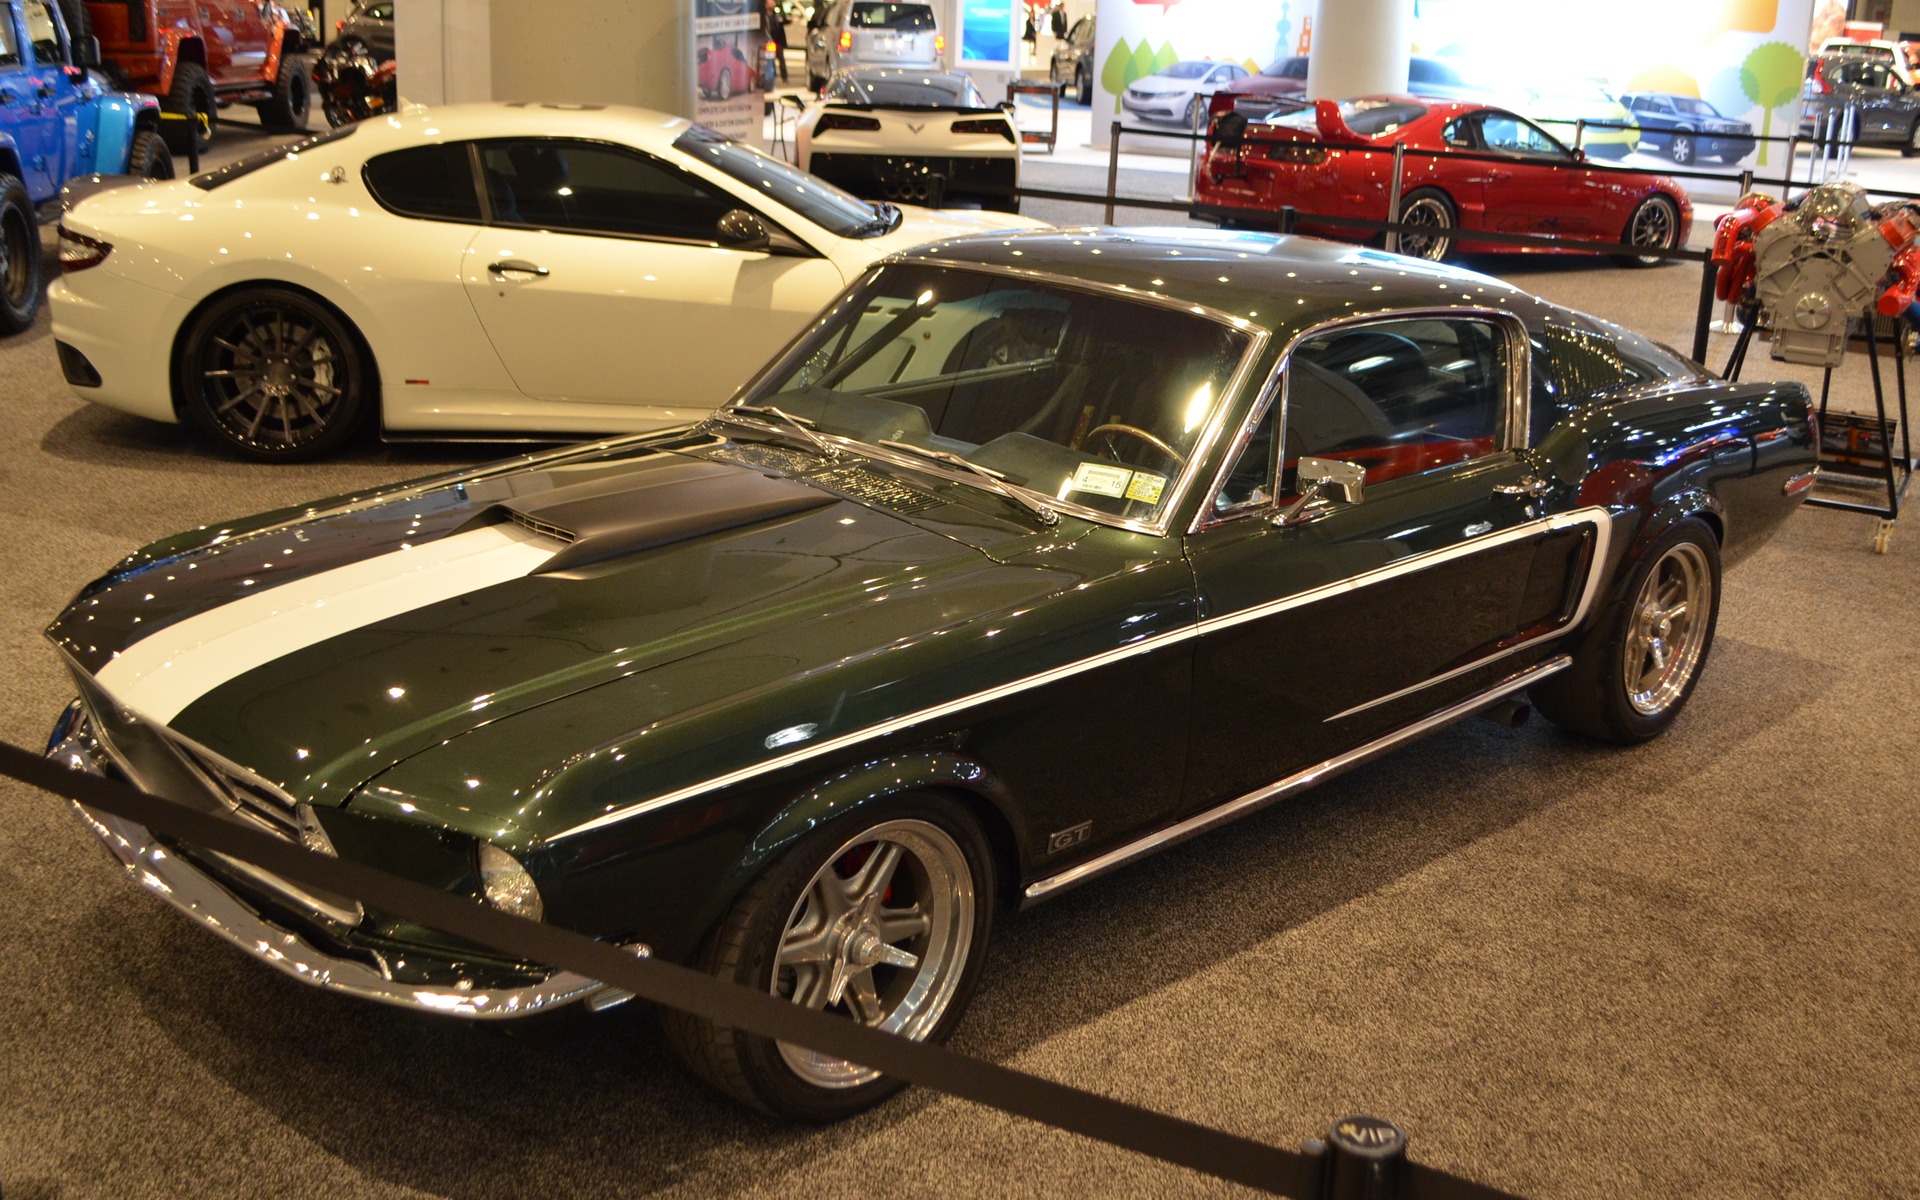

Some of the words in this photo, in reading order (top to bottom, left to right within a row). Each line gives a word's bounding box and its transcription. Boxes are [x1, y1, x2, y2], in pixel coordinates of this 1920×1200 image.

[1111, 480, 1122, 489] 15
[1054, 826, 1090, 848] GT
[1350, 1127, 1397, 1143] VIP
